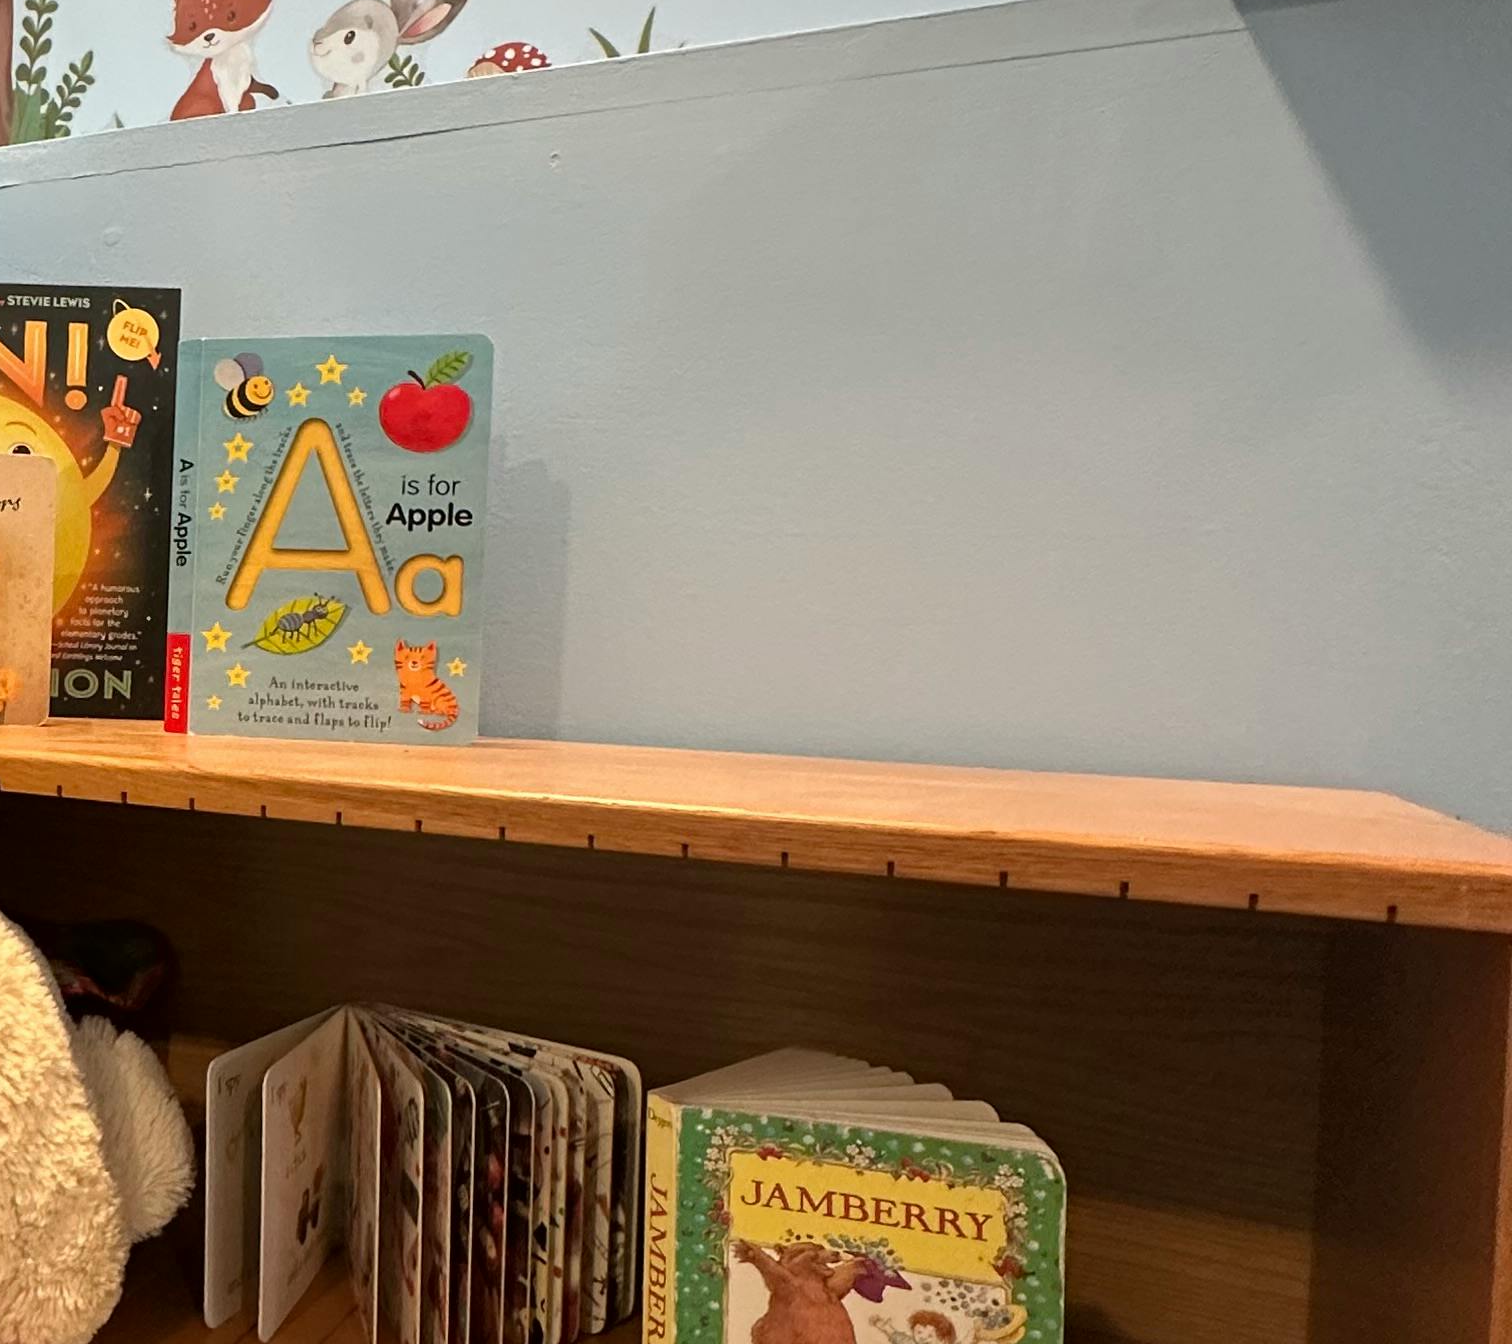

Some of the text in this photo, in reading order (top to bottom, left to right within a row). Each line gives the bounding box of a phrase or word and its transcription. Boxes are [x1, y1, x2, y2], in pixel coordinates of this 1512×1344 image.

[7, 295, 50, 307] STEVIE
[52, 296, 91, 308] LEWIS
[122, 320, 148, 337] FLIP
[336, 423, 348, 441] and
[179, 458, 194, 473] A
[343, 443, 356, 468] trace
[353, 469, 365, 486] the
[401, 473, 461, 496] is for
[217, 426, 293, 584] Run your finger along the tracks
[358, 487, 376, 520] letters
[386, 502, 473, 532] Apple
[174, 511, 193, 567] Apple
[371, 522, 385, 544] they
[51, 668, 132, 699] ION
[171, 646, 184, 720] tiger tales
[268, 676, 360, 692] An interactive
[248, 695, 380, 711] alphabet, with tracks
[238, 712, 393, 732] to trace and flaps to flip!
[740, 1179, 993, 1242] JAMBERRY
